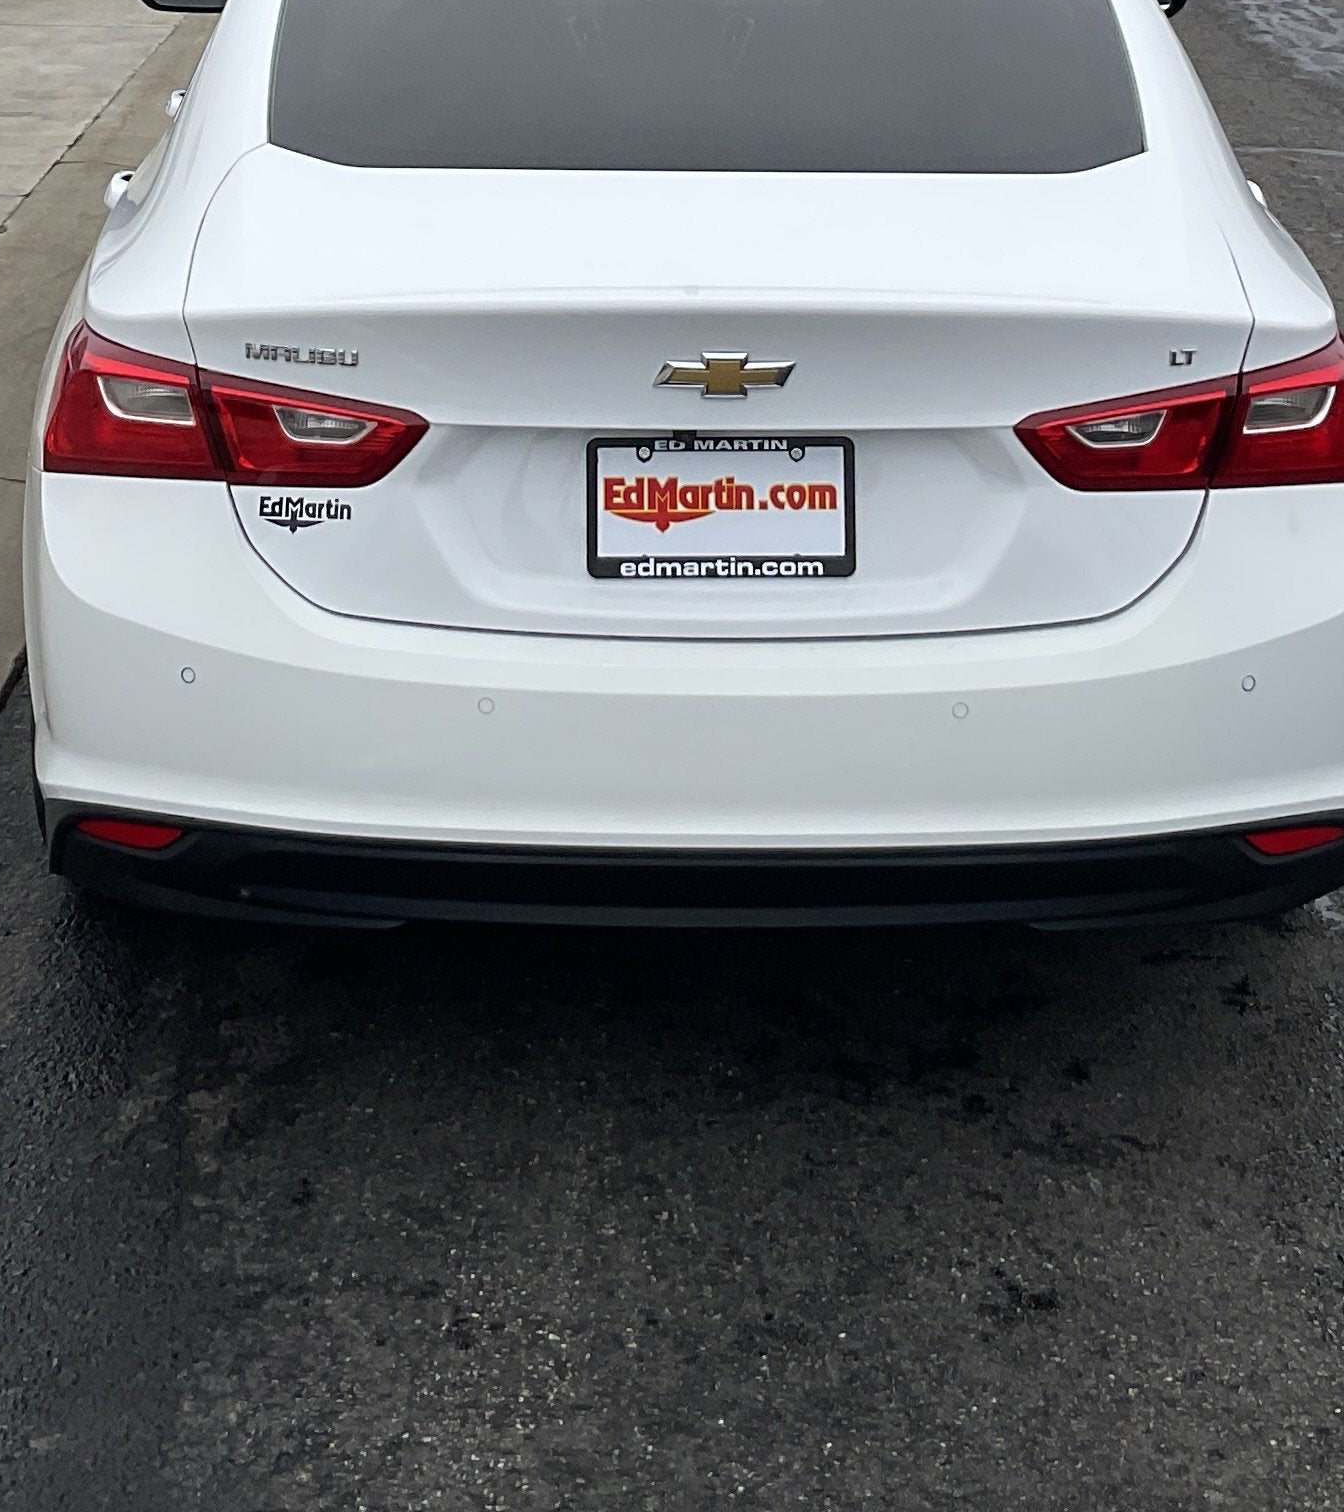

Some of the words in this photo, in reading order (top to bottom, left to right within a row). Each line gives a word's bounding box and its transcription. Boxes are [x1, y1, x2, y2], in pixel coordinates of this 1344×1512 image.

[244, 342, 360, 368] MALIBU
[1168, 347, 1198, 367] LT
[654, 439, 686, 451] ED
[694, 438, 789, 451] MARTIN
[602, 475, 839, 512] EdMartin.com
[258, 495, 353, 521] EdMartin
[619, 556, 824, 578] edmartin.com
